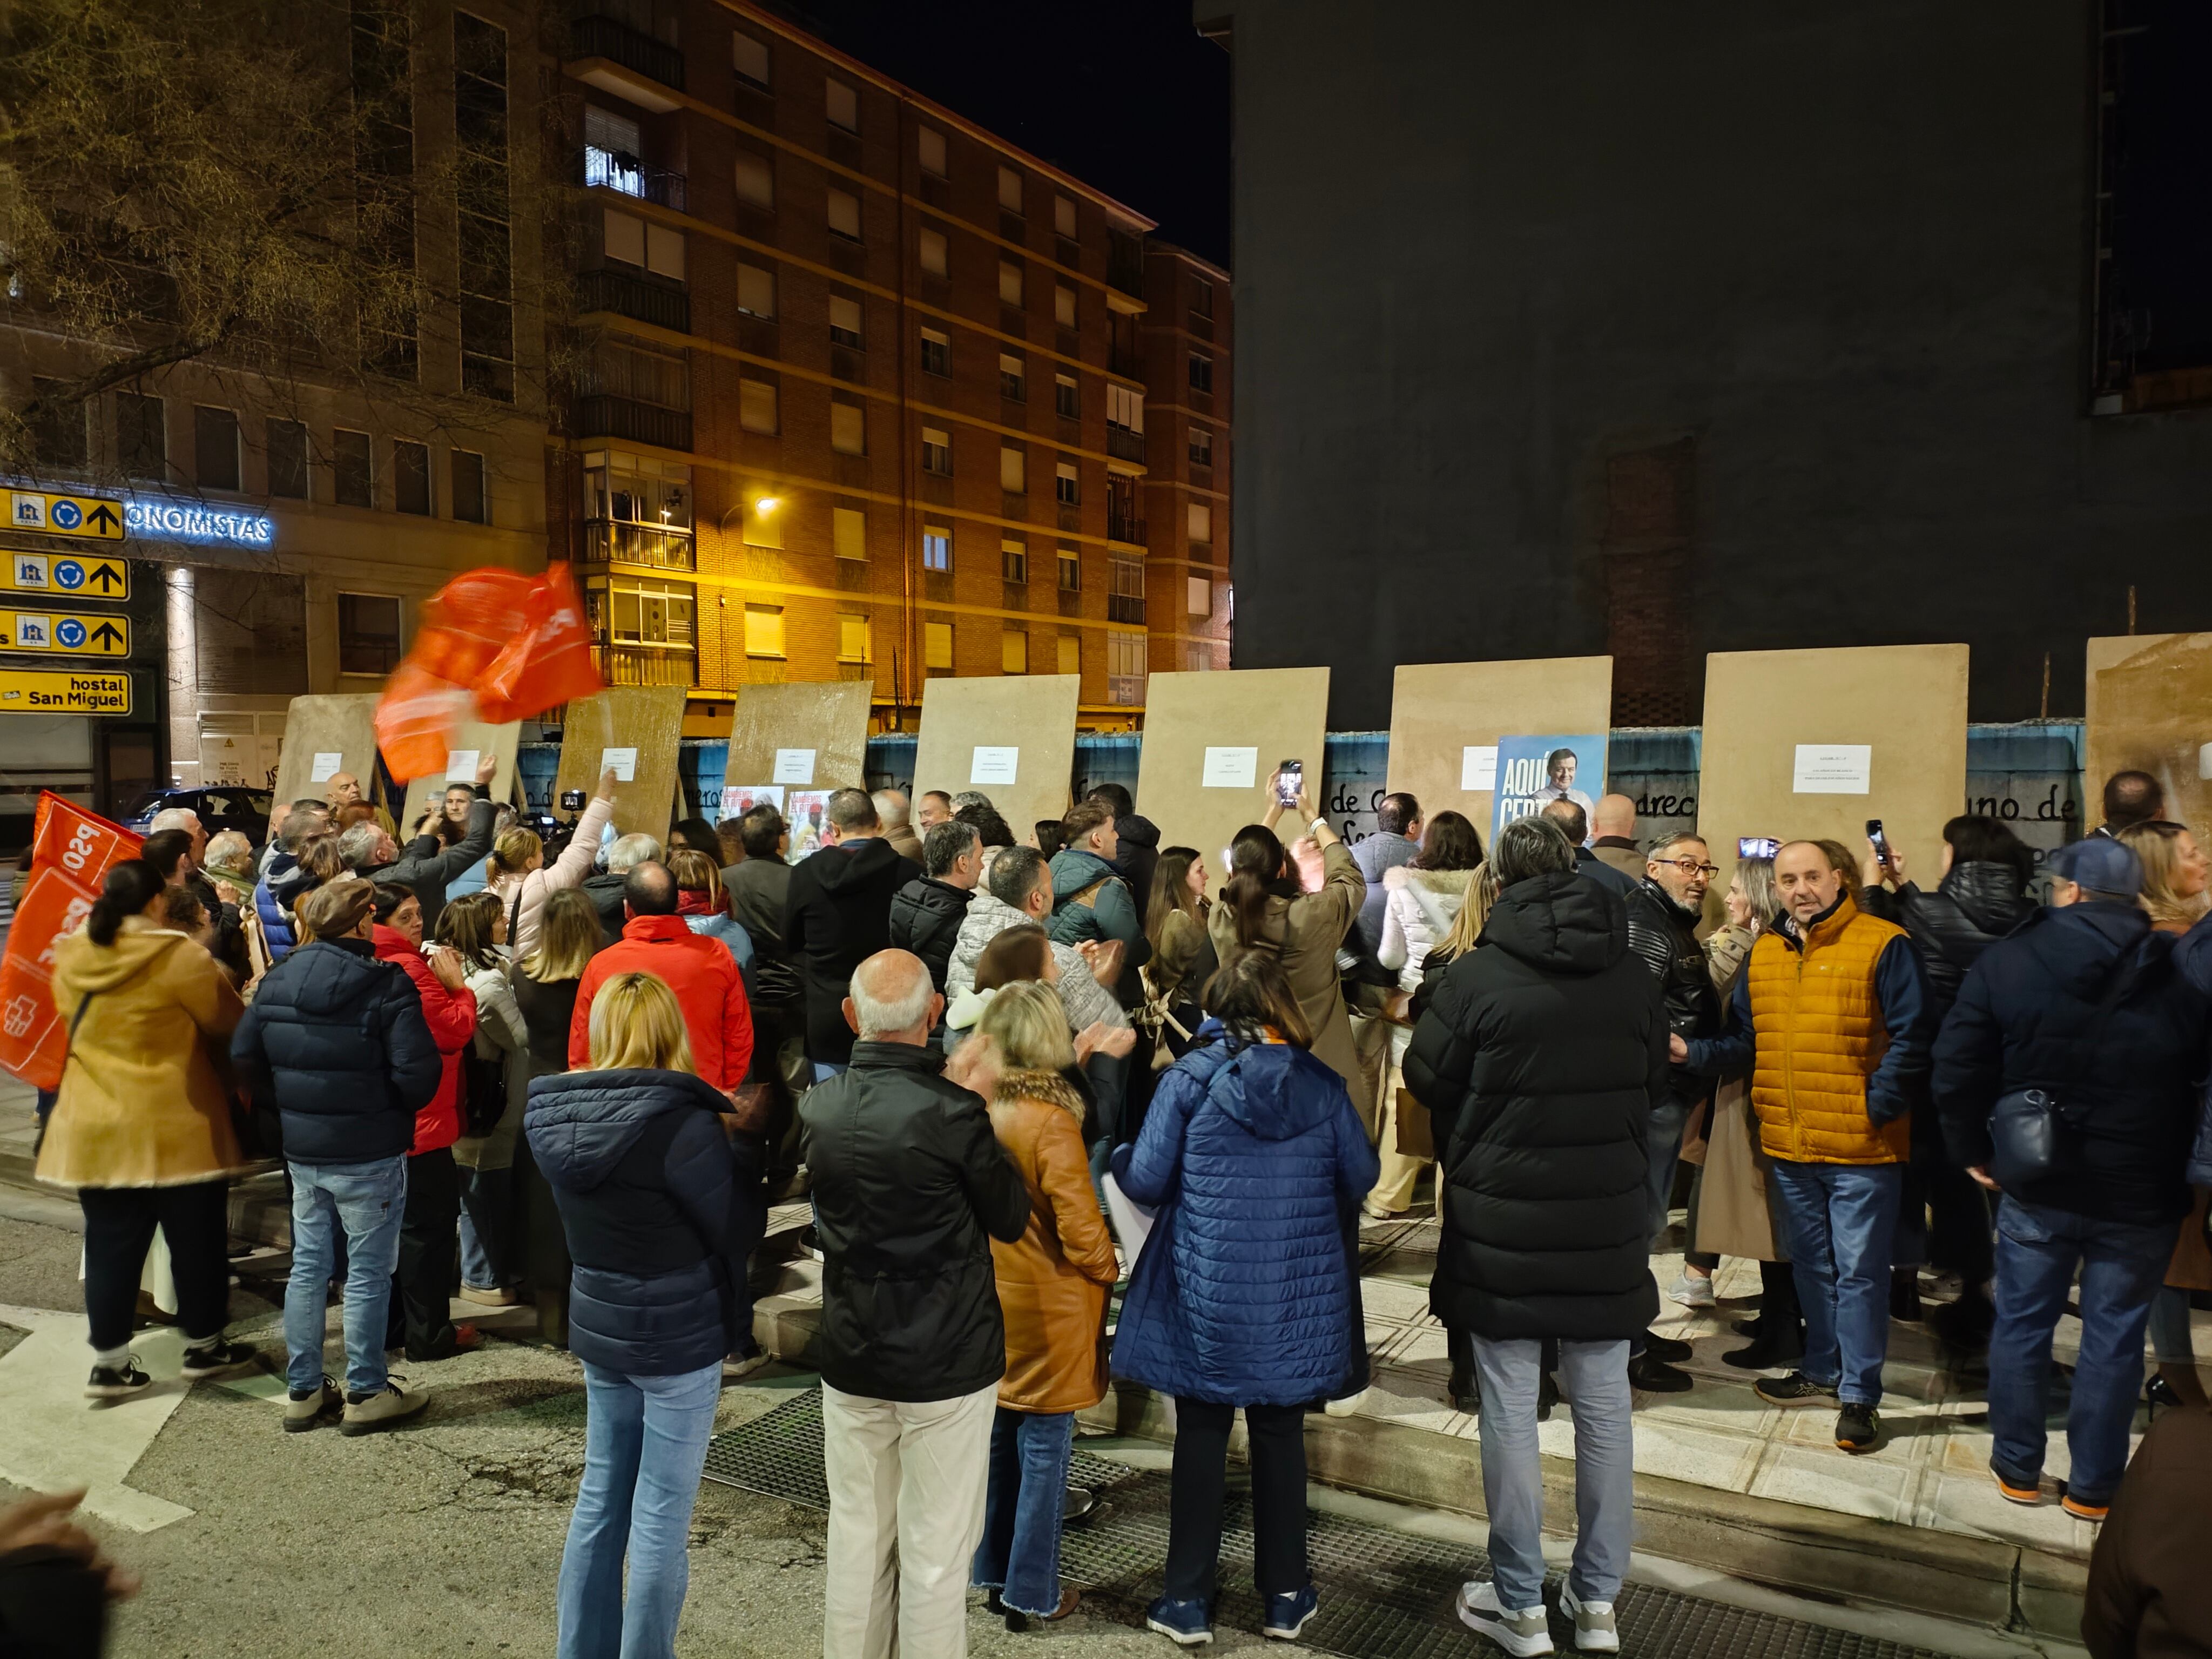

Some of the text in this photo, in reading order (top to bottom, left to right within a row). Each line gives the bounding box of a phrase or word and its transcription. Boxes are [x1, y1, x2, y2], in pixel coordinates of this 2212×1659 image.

[127, 507, 269, 538] ONOMISTAS
[0, 634, 9, 644] s
[71, 678, 124, 691] hostal
[29, 692, 63, 705] San
[68, 692, 124, 710] Miguel
[1502, 751, 1550, 796] AQUÍ
[1331, 783, 1360, 814] de
[2038, 784, 2077, 820] de
